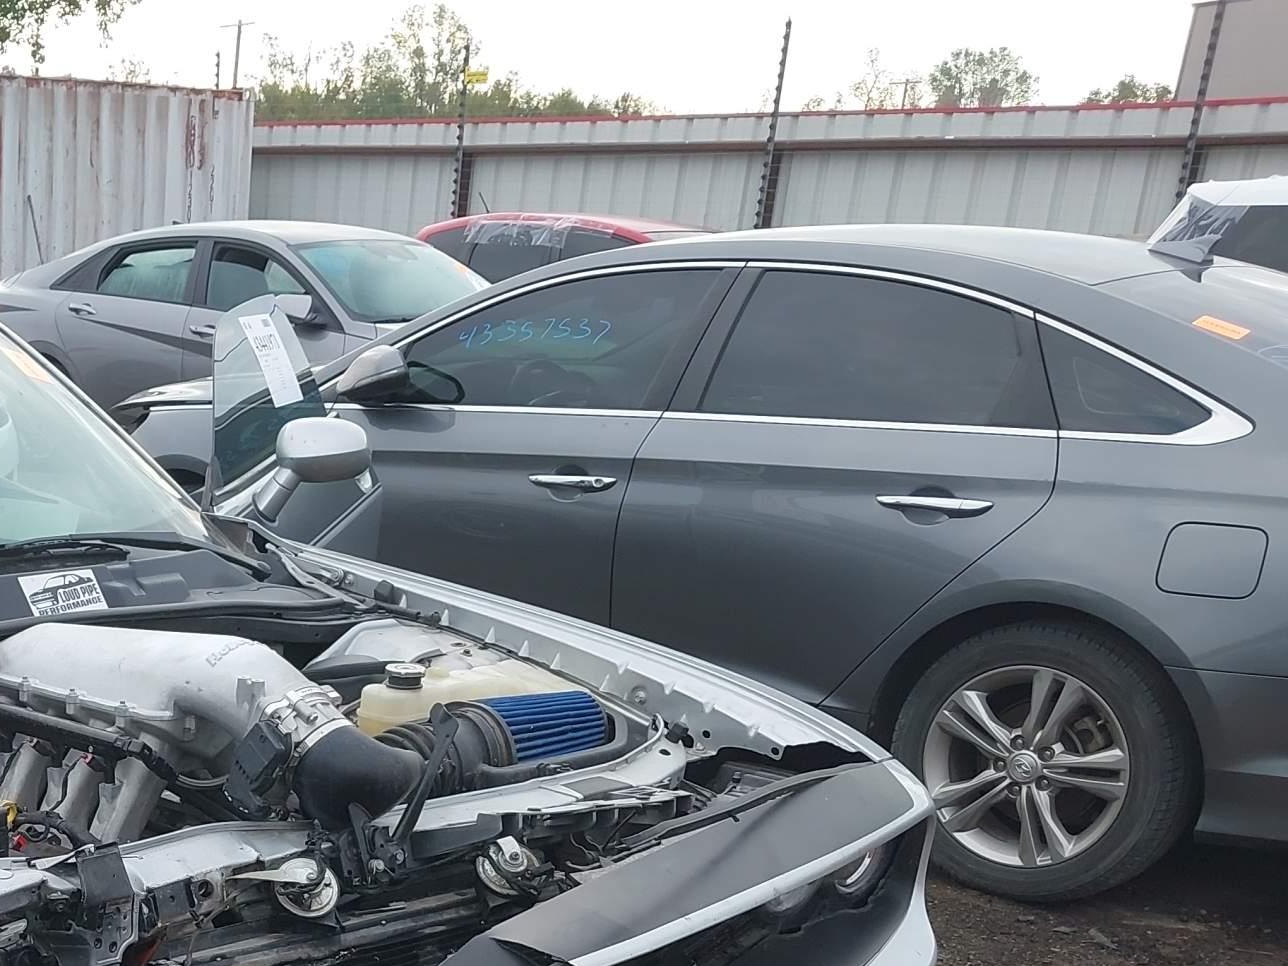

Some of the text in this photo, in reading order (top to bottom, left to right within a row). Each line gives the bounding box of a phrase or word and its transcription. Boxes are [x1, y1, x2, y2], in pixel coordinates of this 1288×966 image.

[58, 582, 101, 603] LOUD PIPE
[38, 596, 104, 616] PERFORMANCE
